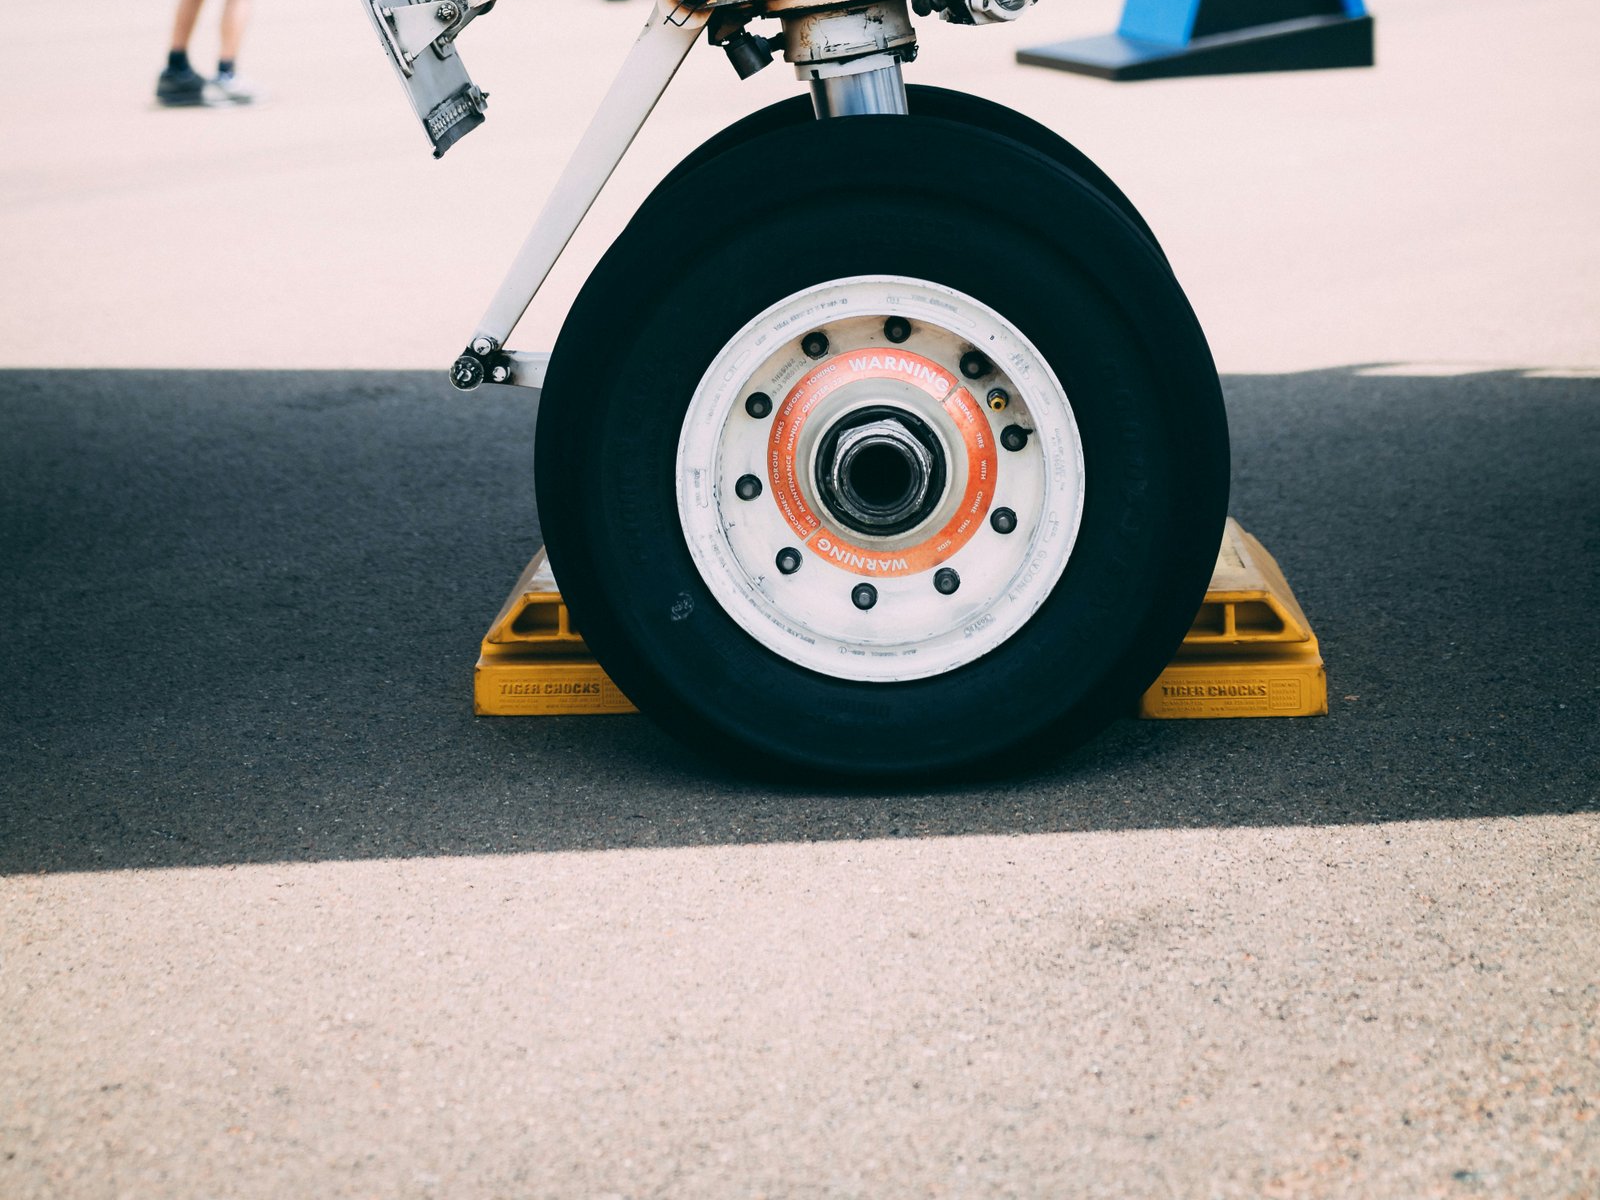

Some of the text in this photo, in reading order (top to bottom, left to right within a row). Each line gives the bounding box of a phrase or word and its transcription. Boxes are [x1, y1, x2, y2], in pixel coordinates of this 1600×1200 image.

[806, 364, 837, 386] TOWING
[848, 355, 950, 393] WARNING
[784, 388, 804, 416] BEFORE
[802, 384, 832, 413] CHAPTER
[955, 398, 974, 423] INSTALL
[774, 421, 785, 444] LINKS
[787, 416, 803, 451] MANUAL
[975, 432, 984, 449] TIRE
[772, 450, 780, 484] TORQUE
[786, 455, 806, 513] MAINTENANCE
[777, 490, 807, 536] DISCONNECT
[970, 491, 983, 514] CHINE
[805, 515, 817, 527] SEE
[957, 519, 970, 534] THIS
[816, 538, 909, 572] WARNING
[937, 539, 951, 552] SIDE
[500, 683, 600, 694] TIGER CHOCKS
[1161, 685, 1205, 697] TIGER
[1207, 685, 1267, 697] CHOCKS
